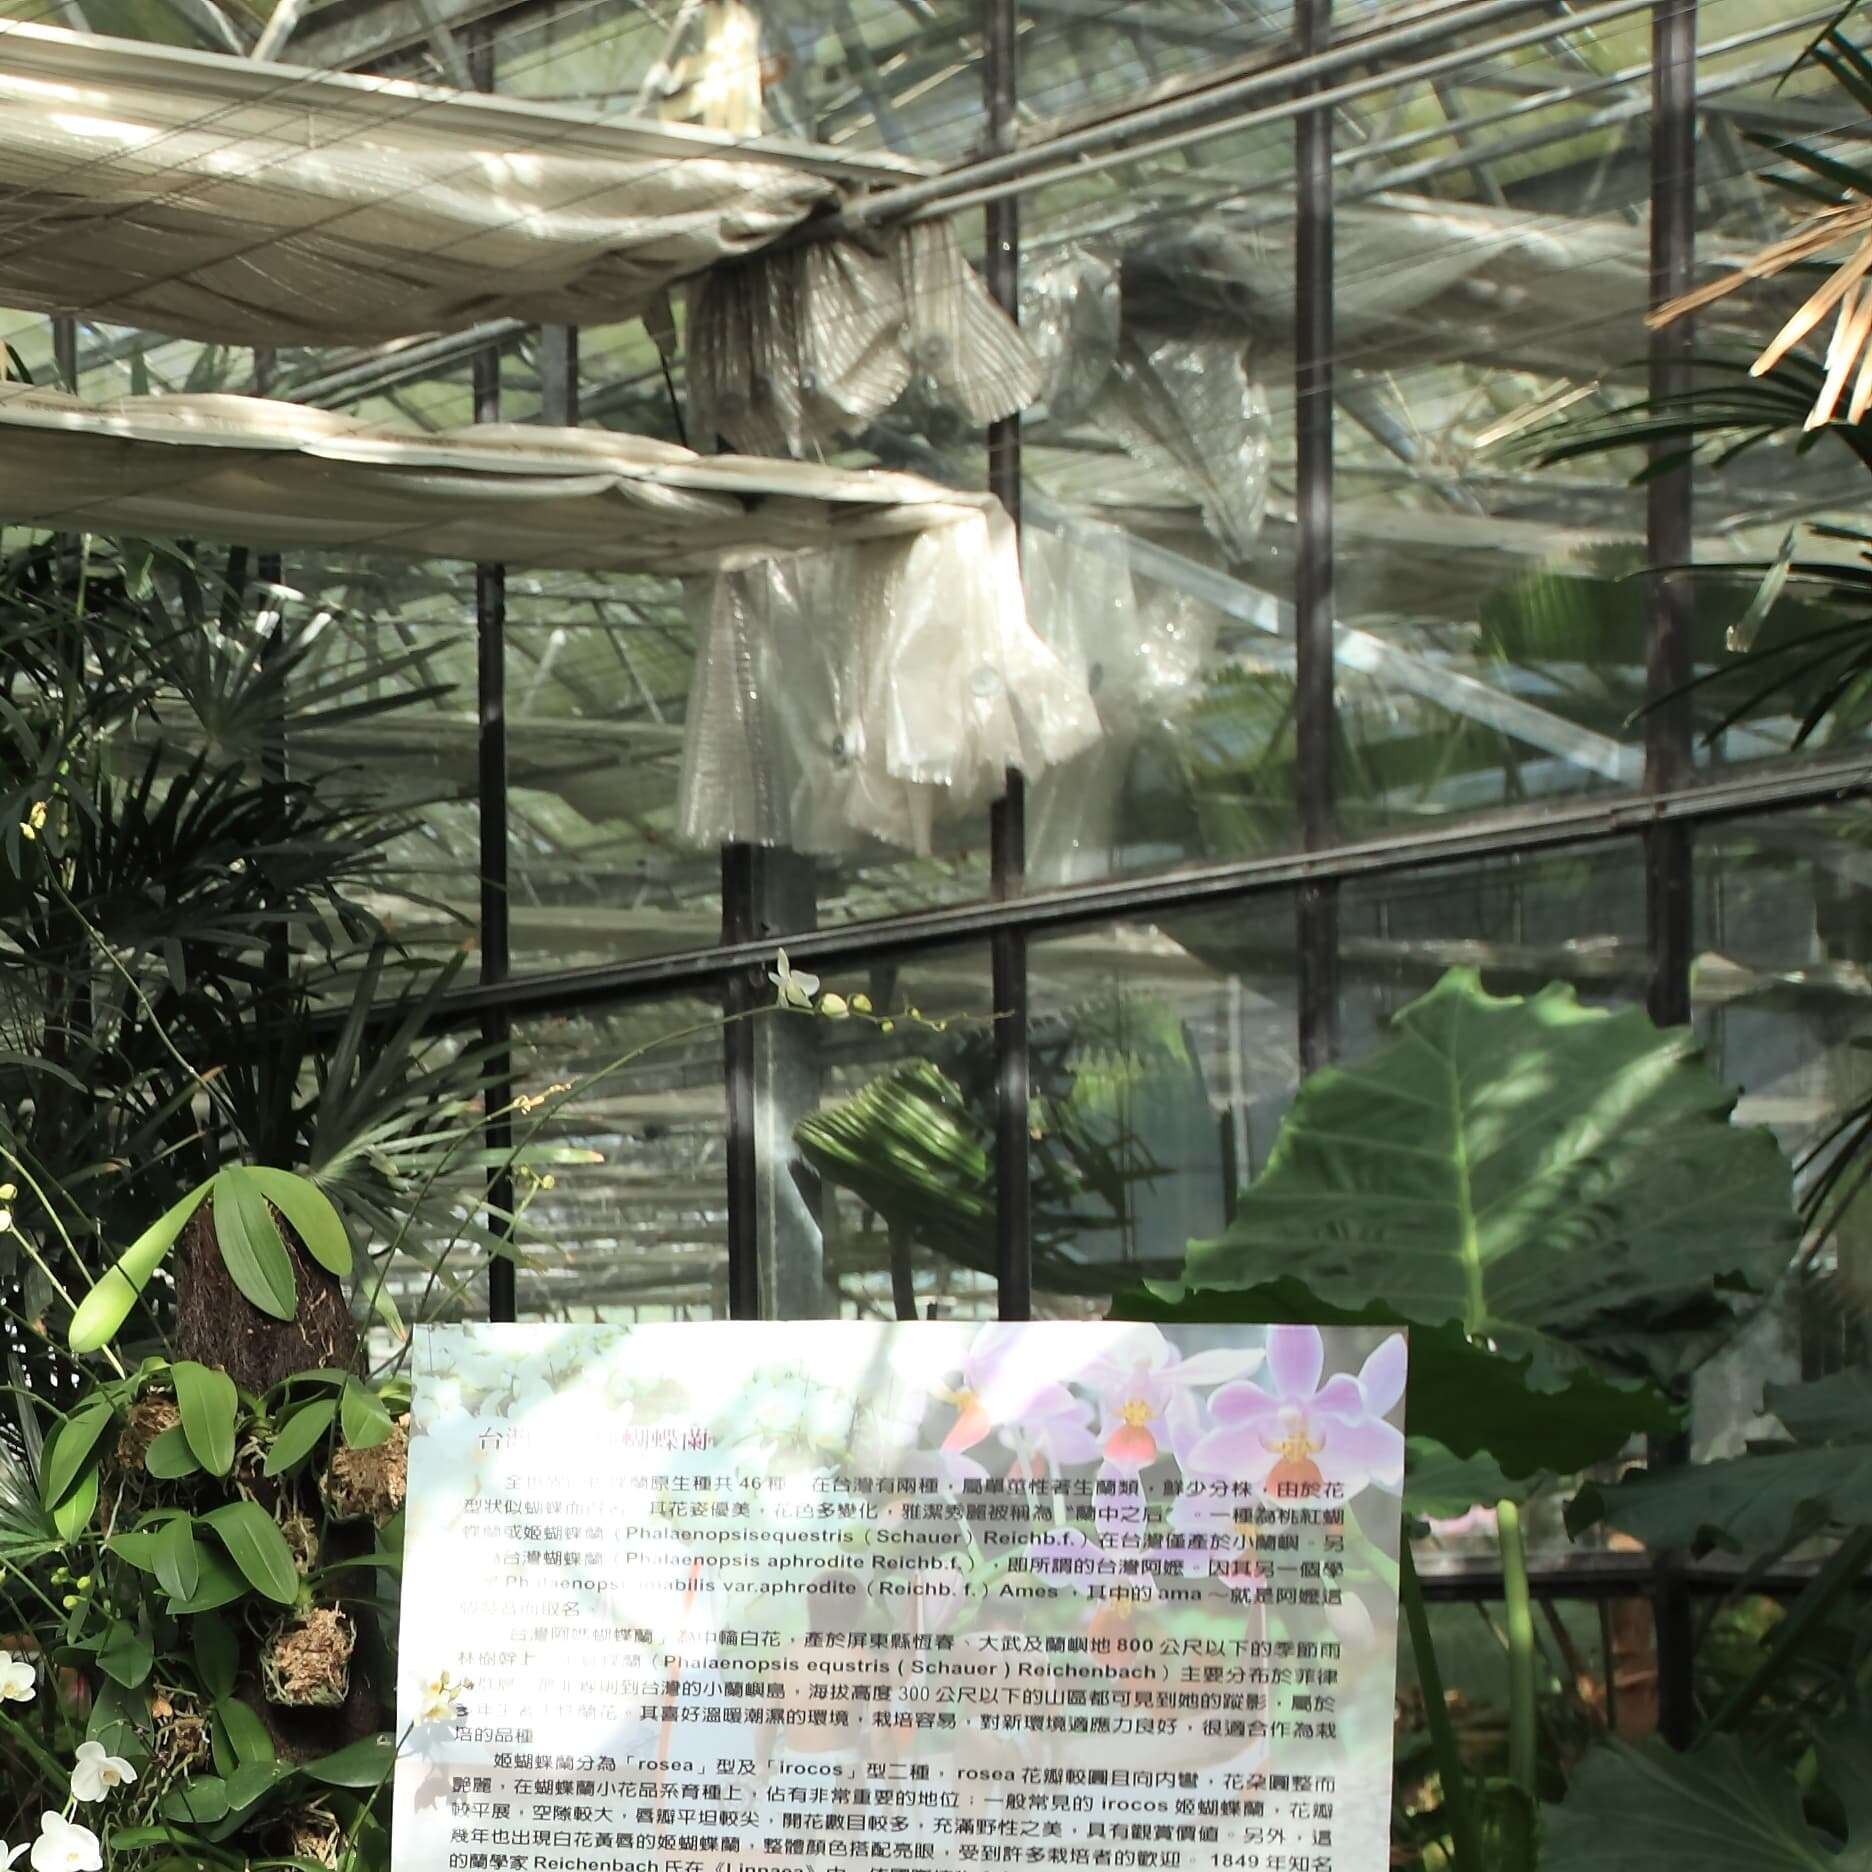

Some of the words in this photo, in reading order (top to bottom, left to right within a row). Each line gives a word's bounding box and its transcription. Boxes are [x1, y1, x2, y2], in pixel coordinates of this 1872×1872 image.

[739, 1476, 762, 1490] 46
[767, 1554, 864, 1572] aphrodite
[1000, 1584, 1058, 1598] Ames
[1158, 1588, 1202, 1600] ama
[1117, 1639, 1154, 1652] 800
[806, 1660, 890, 1677] equstris
[898, 1686, 930, 1701] 300
[957, 1768, 1016, 1781] rosea
[1102, 1796, 1168, 1812] irocos
[534, 1856, 658, 1872] Reichenbach
[1210, 1853, 1260, 1868] 1849
